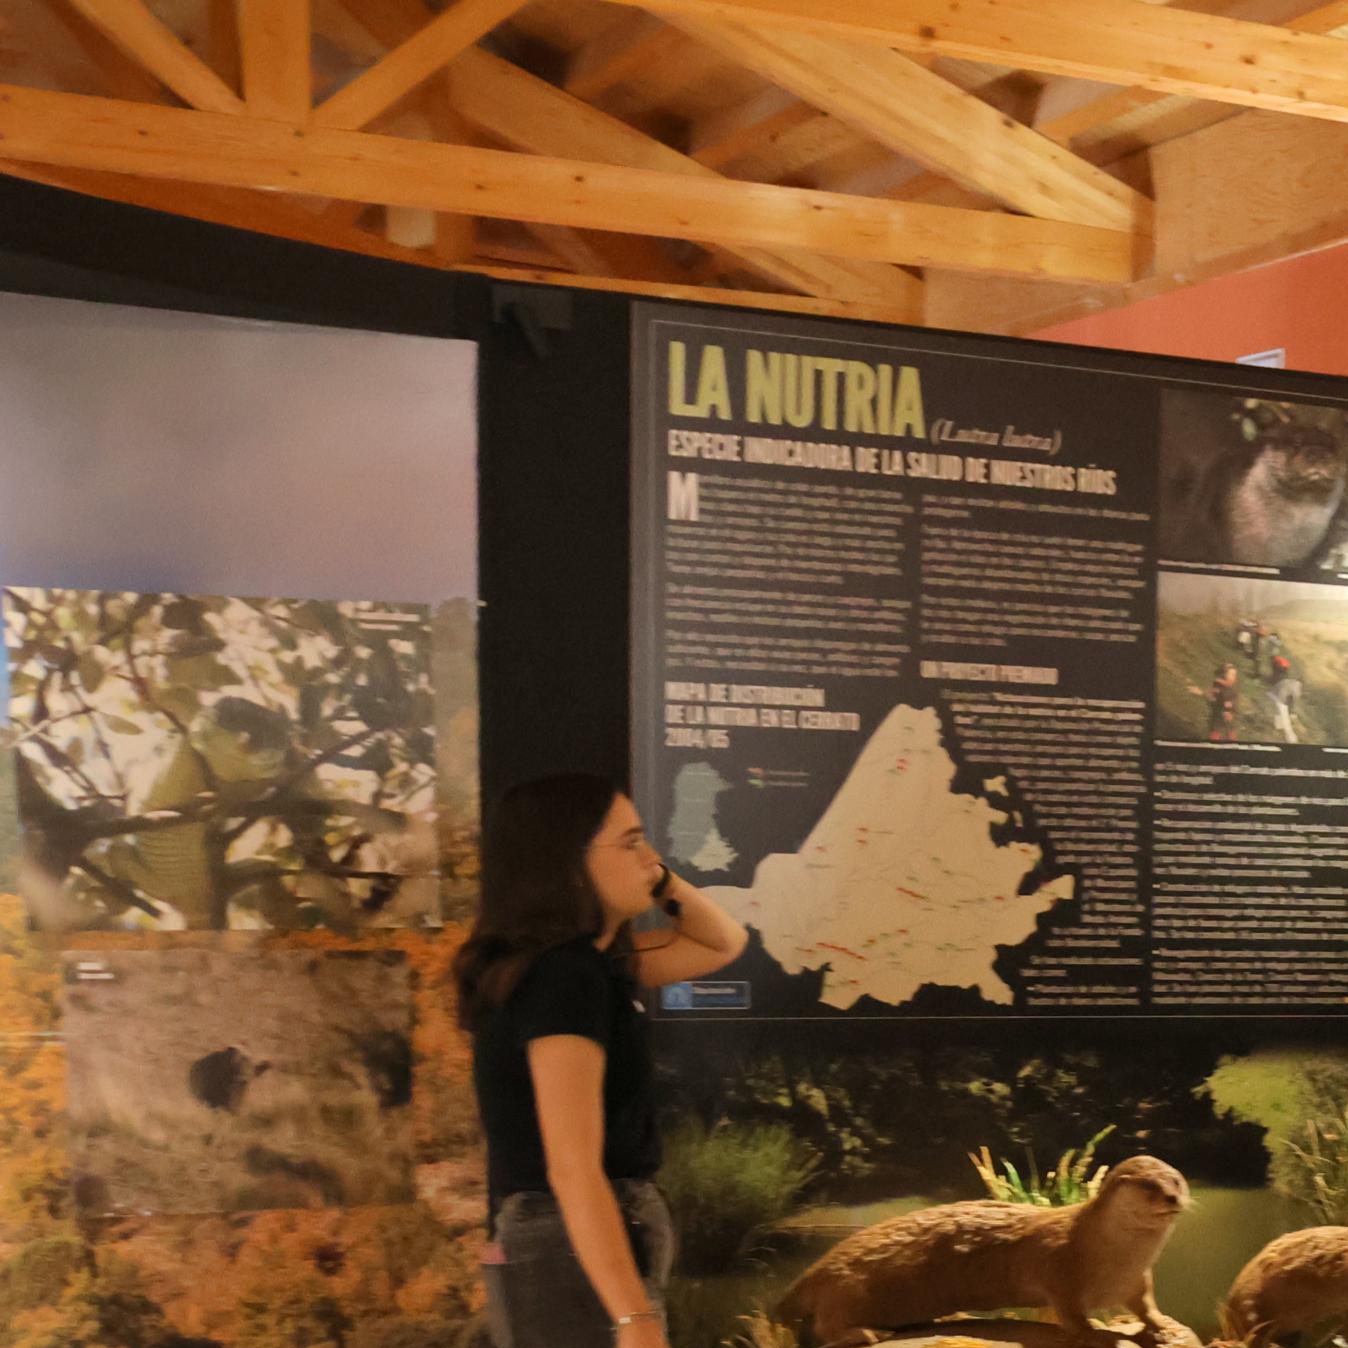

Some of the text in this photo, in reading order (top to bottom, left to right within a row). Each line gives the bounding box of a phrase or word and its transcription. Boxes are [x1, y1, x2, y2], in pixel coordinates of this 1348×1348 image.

[668, 340, 926, 439] LA NUTRIA
[668, 429, 742, 461] ESPECIE
